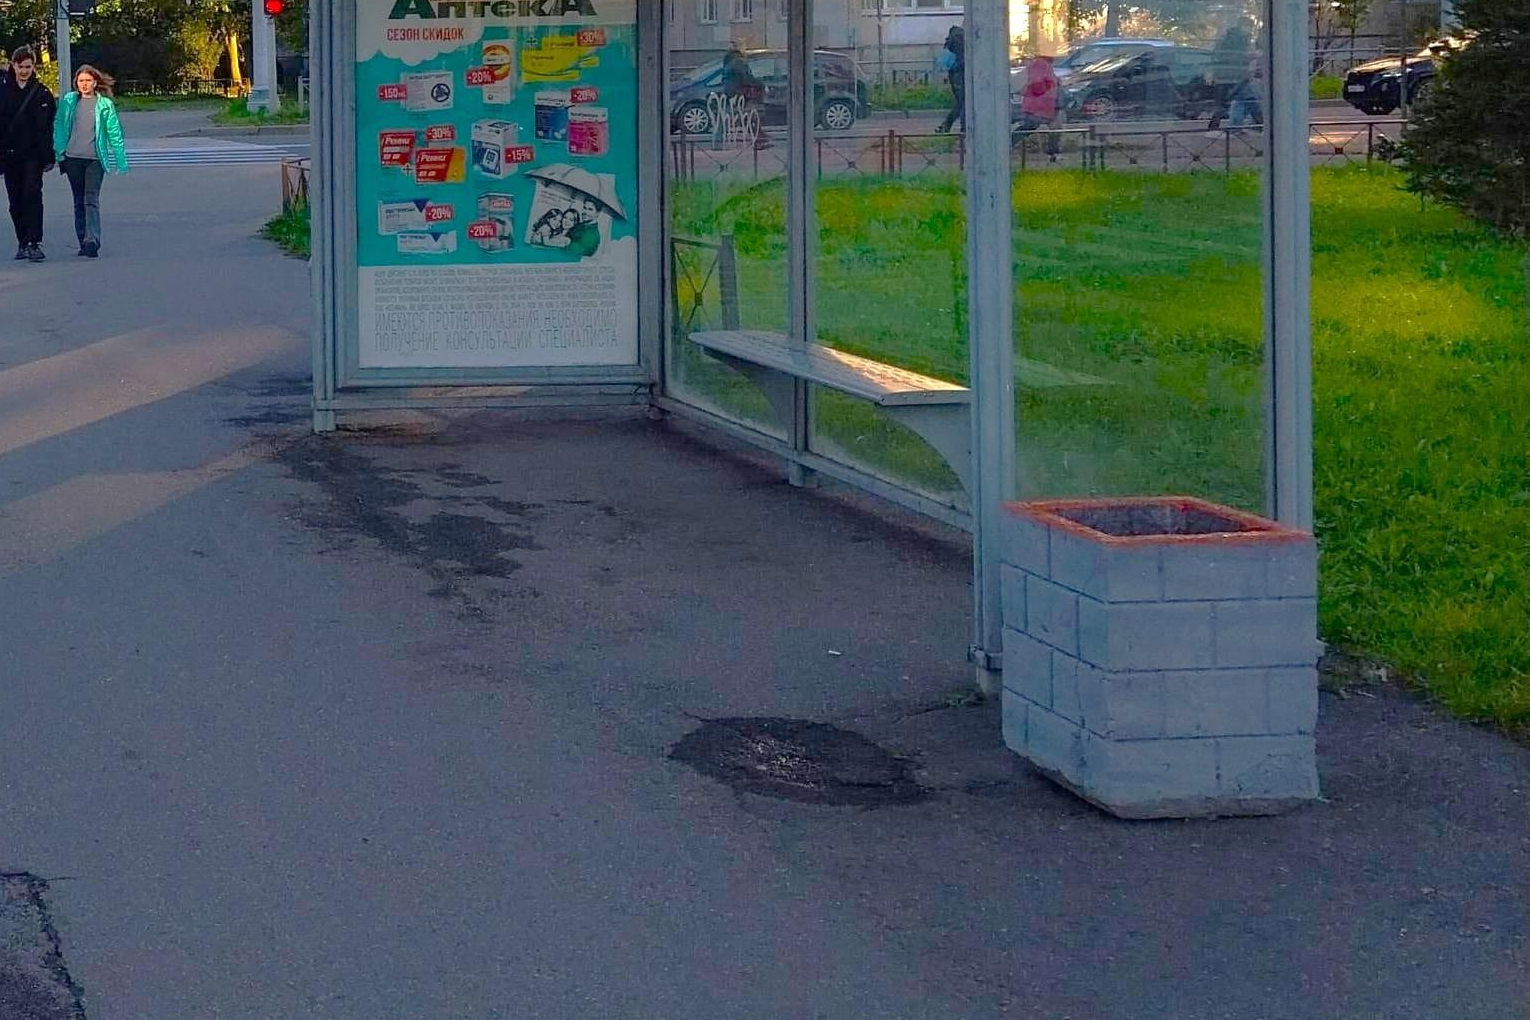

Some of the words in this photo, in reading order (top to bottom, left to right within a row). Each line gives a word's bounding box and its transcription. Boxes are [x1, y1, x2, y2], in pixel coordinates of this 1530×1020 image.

[387, 28, 420, 41] СЕЗОН
[423, 27, 464, 41] СКИДОК
[580, 30, 605, 43] -30%
[467, 70, 492, 84] -20%
[573, 88, 597, 101] -20%
[427, 127, 452, 139] -30%
[507, 149, 531, 162] -15%
[428, 207, 451, 220] -20%
[470, 225, 494, 237] -20%
[374, 311, 426, 332] ИМЕЮТСЯ
[544, 308, 618, 330] НЕОБХОДИМО
[374, 331, 438, 352] ПОЛУЧЕНИЕ
[445, 330, 532, 351] КОНСУЛЬТАЦИИ
[538, 329, 619, 350] СПЕЦИАЛИСТА
